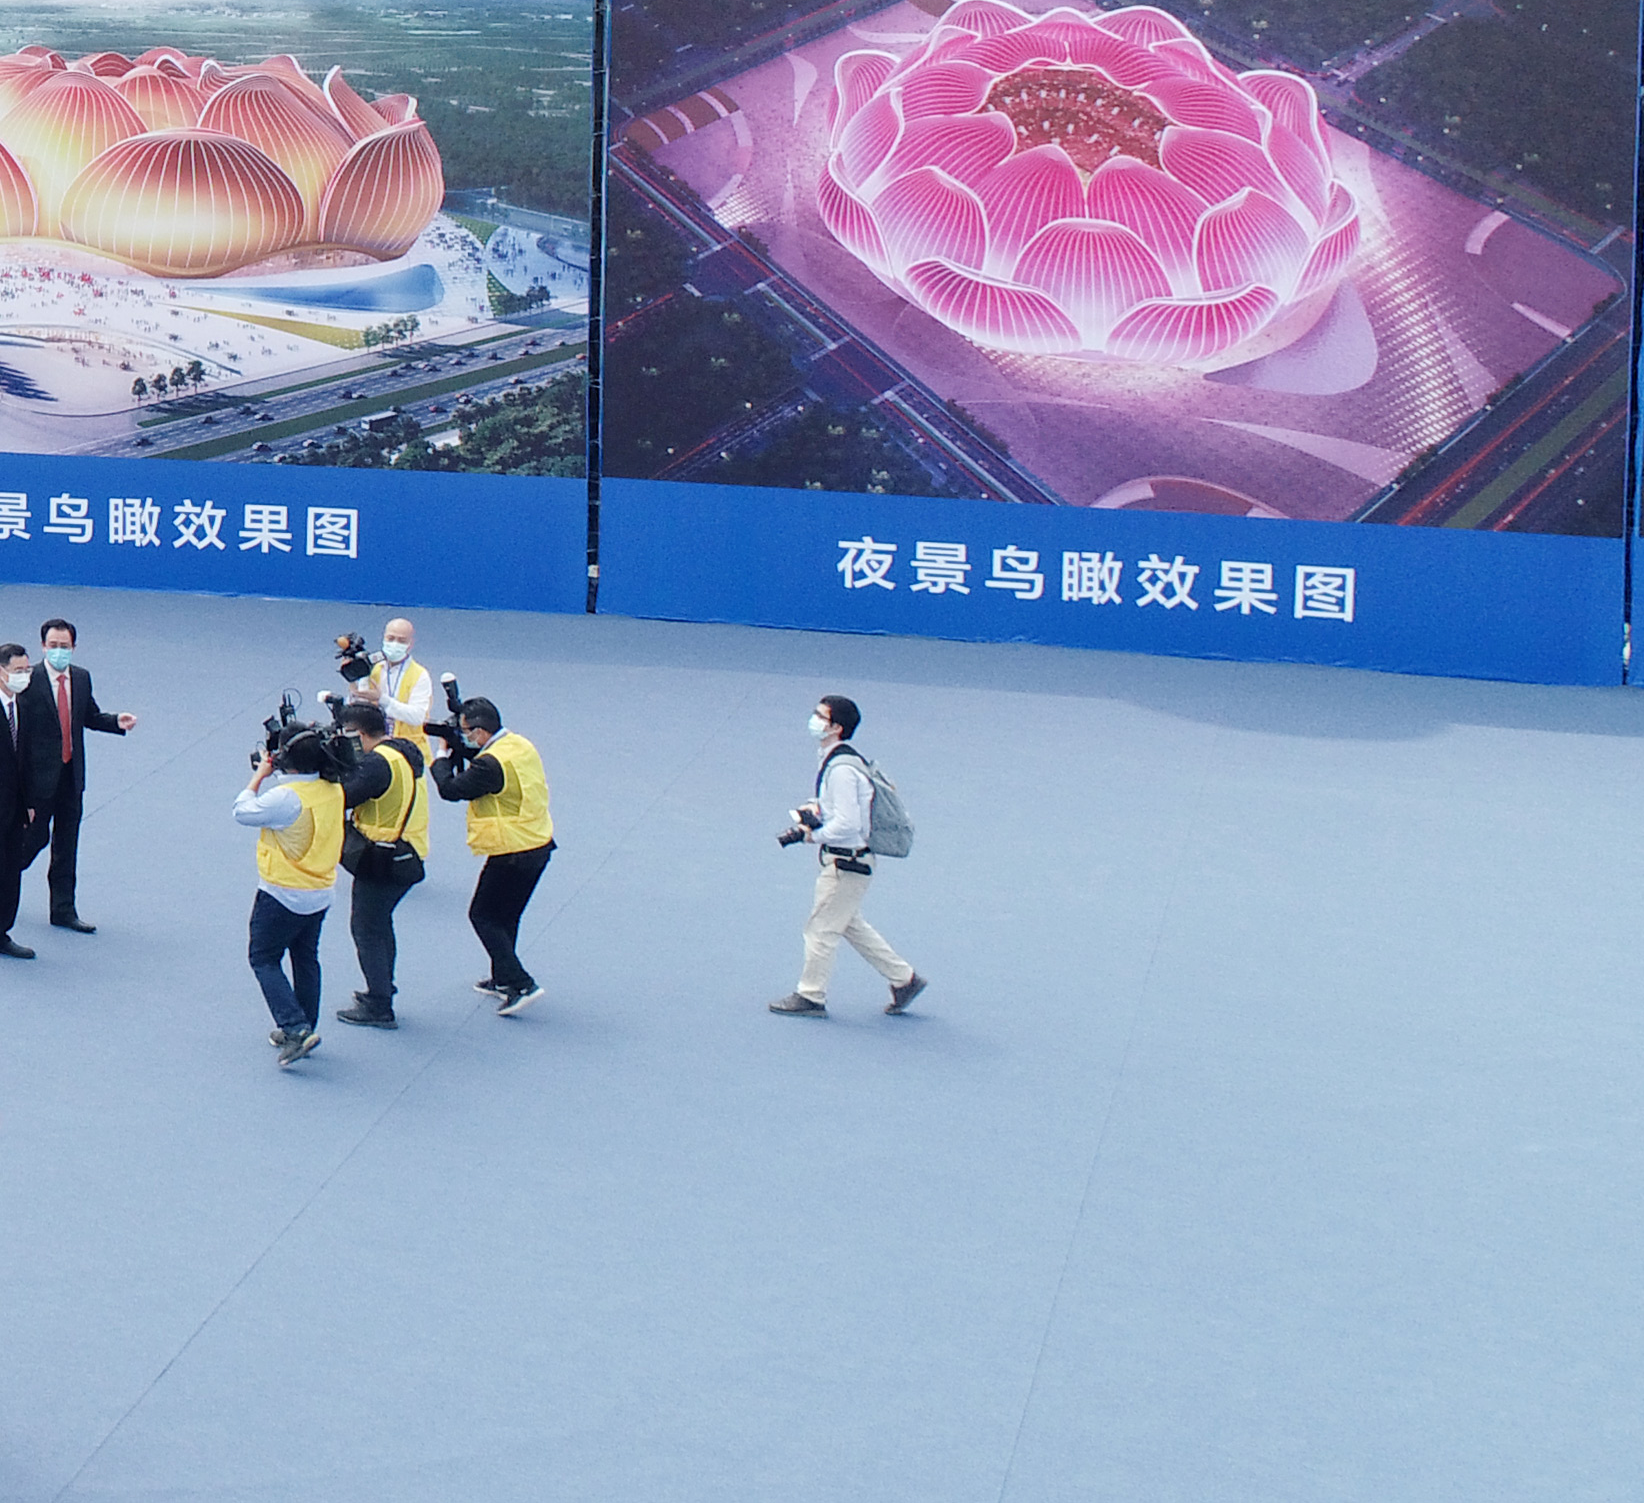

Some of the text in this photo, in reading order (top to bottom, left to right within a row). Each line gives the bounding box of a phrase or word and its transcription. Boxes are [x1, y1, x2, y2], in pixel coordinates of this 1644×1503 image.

[837, 536, 1356, 623] 夜景鸟瞰效果图
